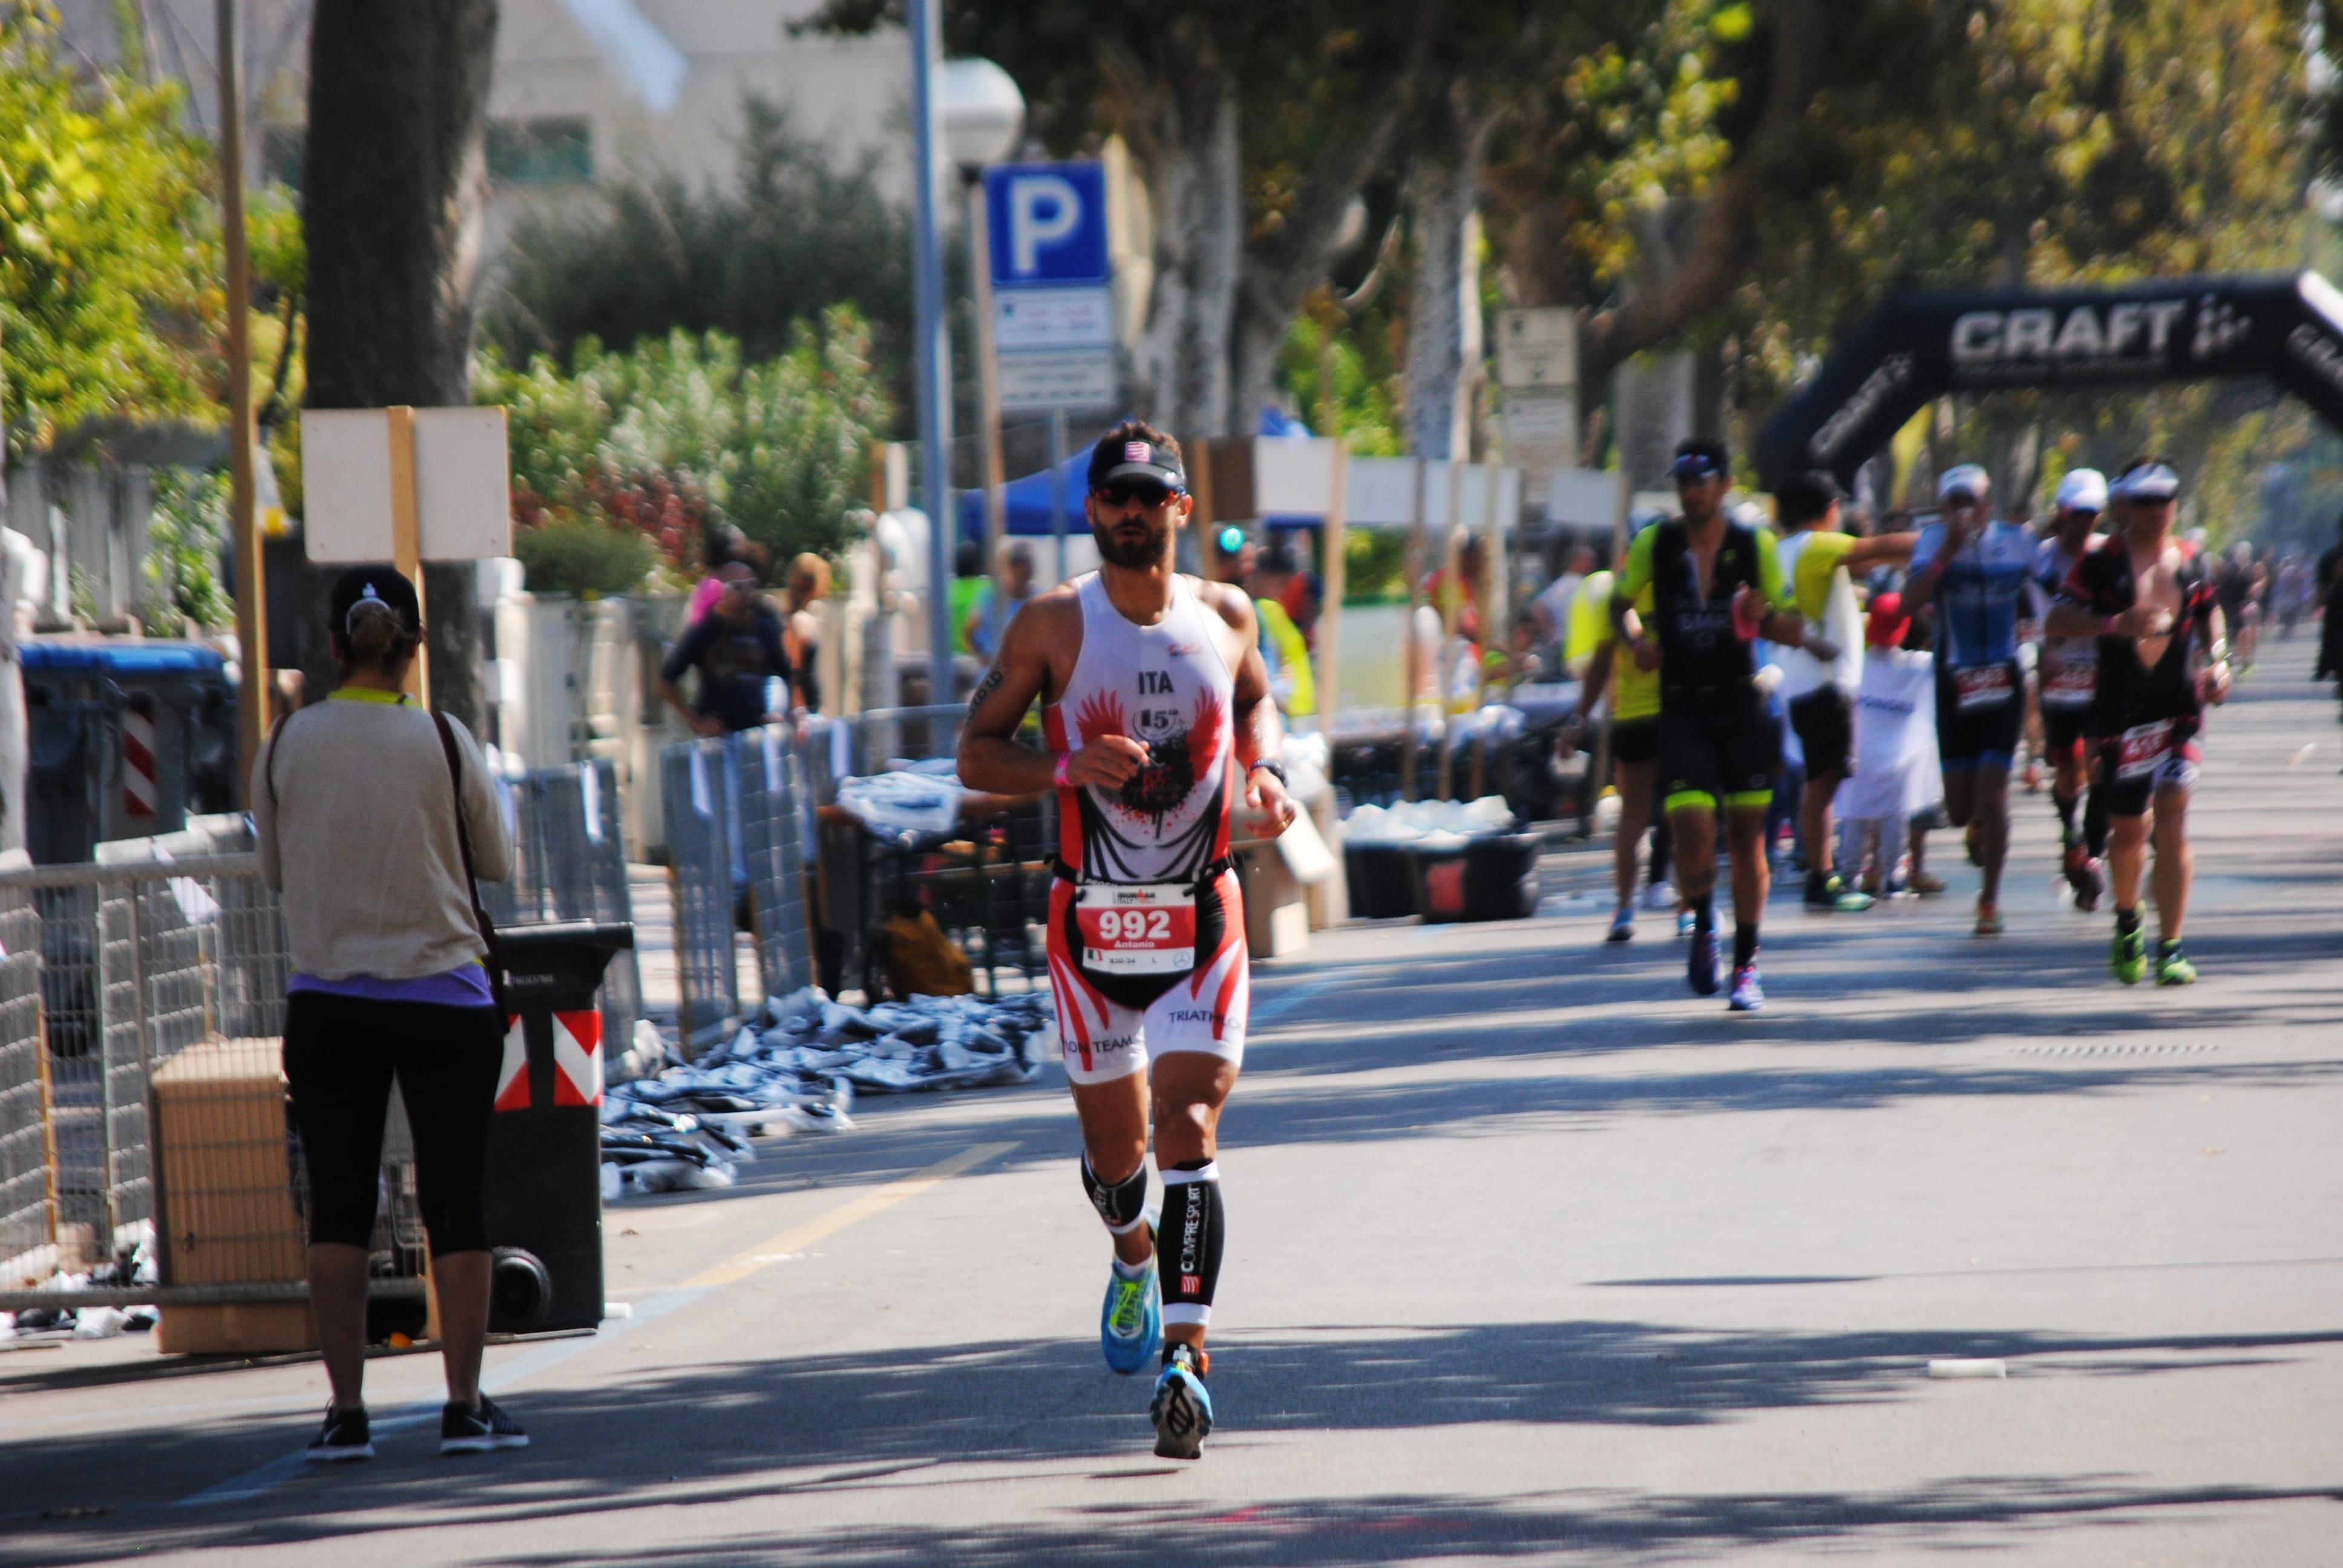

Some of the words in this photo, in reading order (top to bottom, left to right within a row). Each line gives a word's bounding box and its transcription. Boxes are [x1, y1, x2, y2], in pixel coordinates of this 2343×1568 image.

[1012, 176, 1082, 273] P
[1950, 300, 2186, 357] CRAFT
[1138, 670, 1174, 694] ITA
[1099, 909, 1171, 939] 992
[1114, 939, 1155, 949] Antonio
[1092, 1033, 1133, 1053] TEAM
[1180, 1184, 1201, 1273] COMPRESPORT
